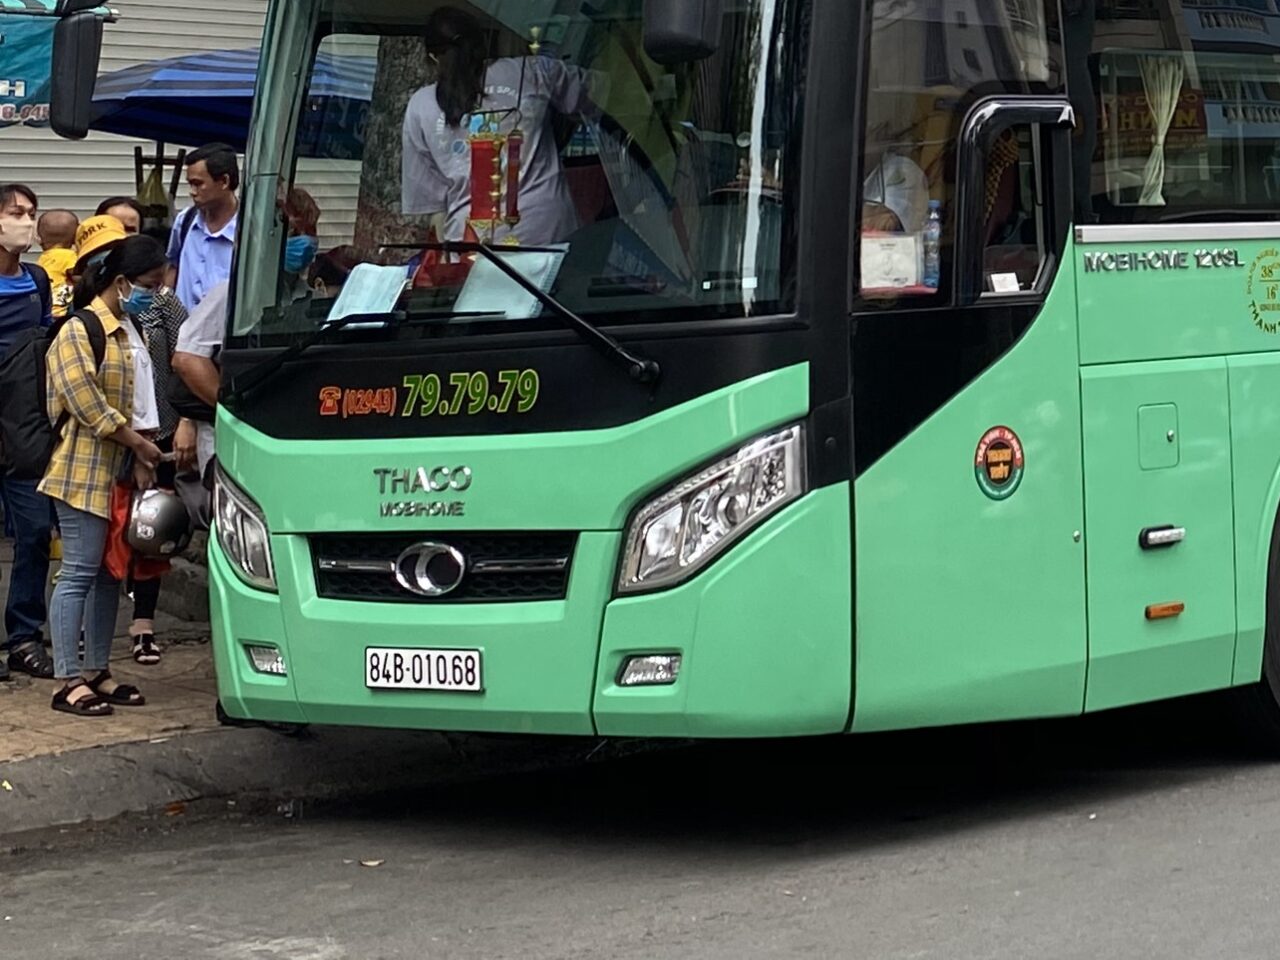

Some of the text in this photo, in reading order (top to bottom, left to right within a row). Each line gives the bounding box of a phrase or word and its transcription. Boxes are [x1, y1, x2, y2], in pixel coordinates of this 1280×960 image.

[1084, 249, 1190, 273] MOBIHOME
[402, 368, 540, 418] 79.79.79
[373, 465, 473, 494] THACO
[380, 501, 465, 517] MOBIHOME
[369, 652, 476, 686] 84B-010.68
